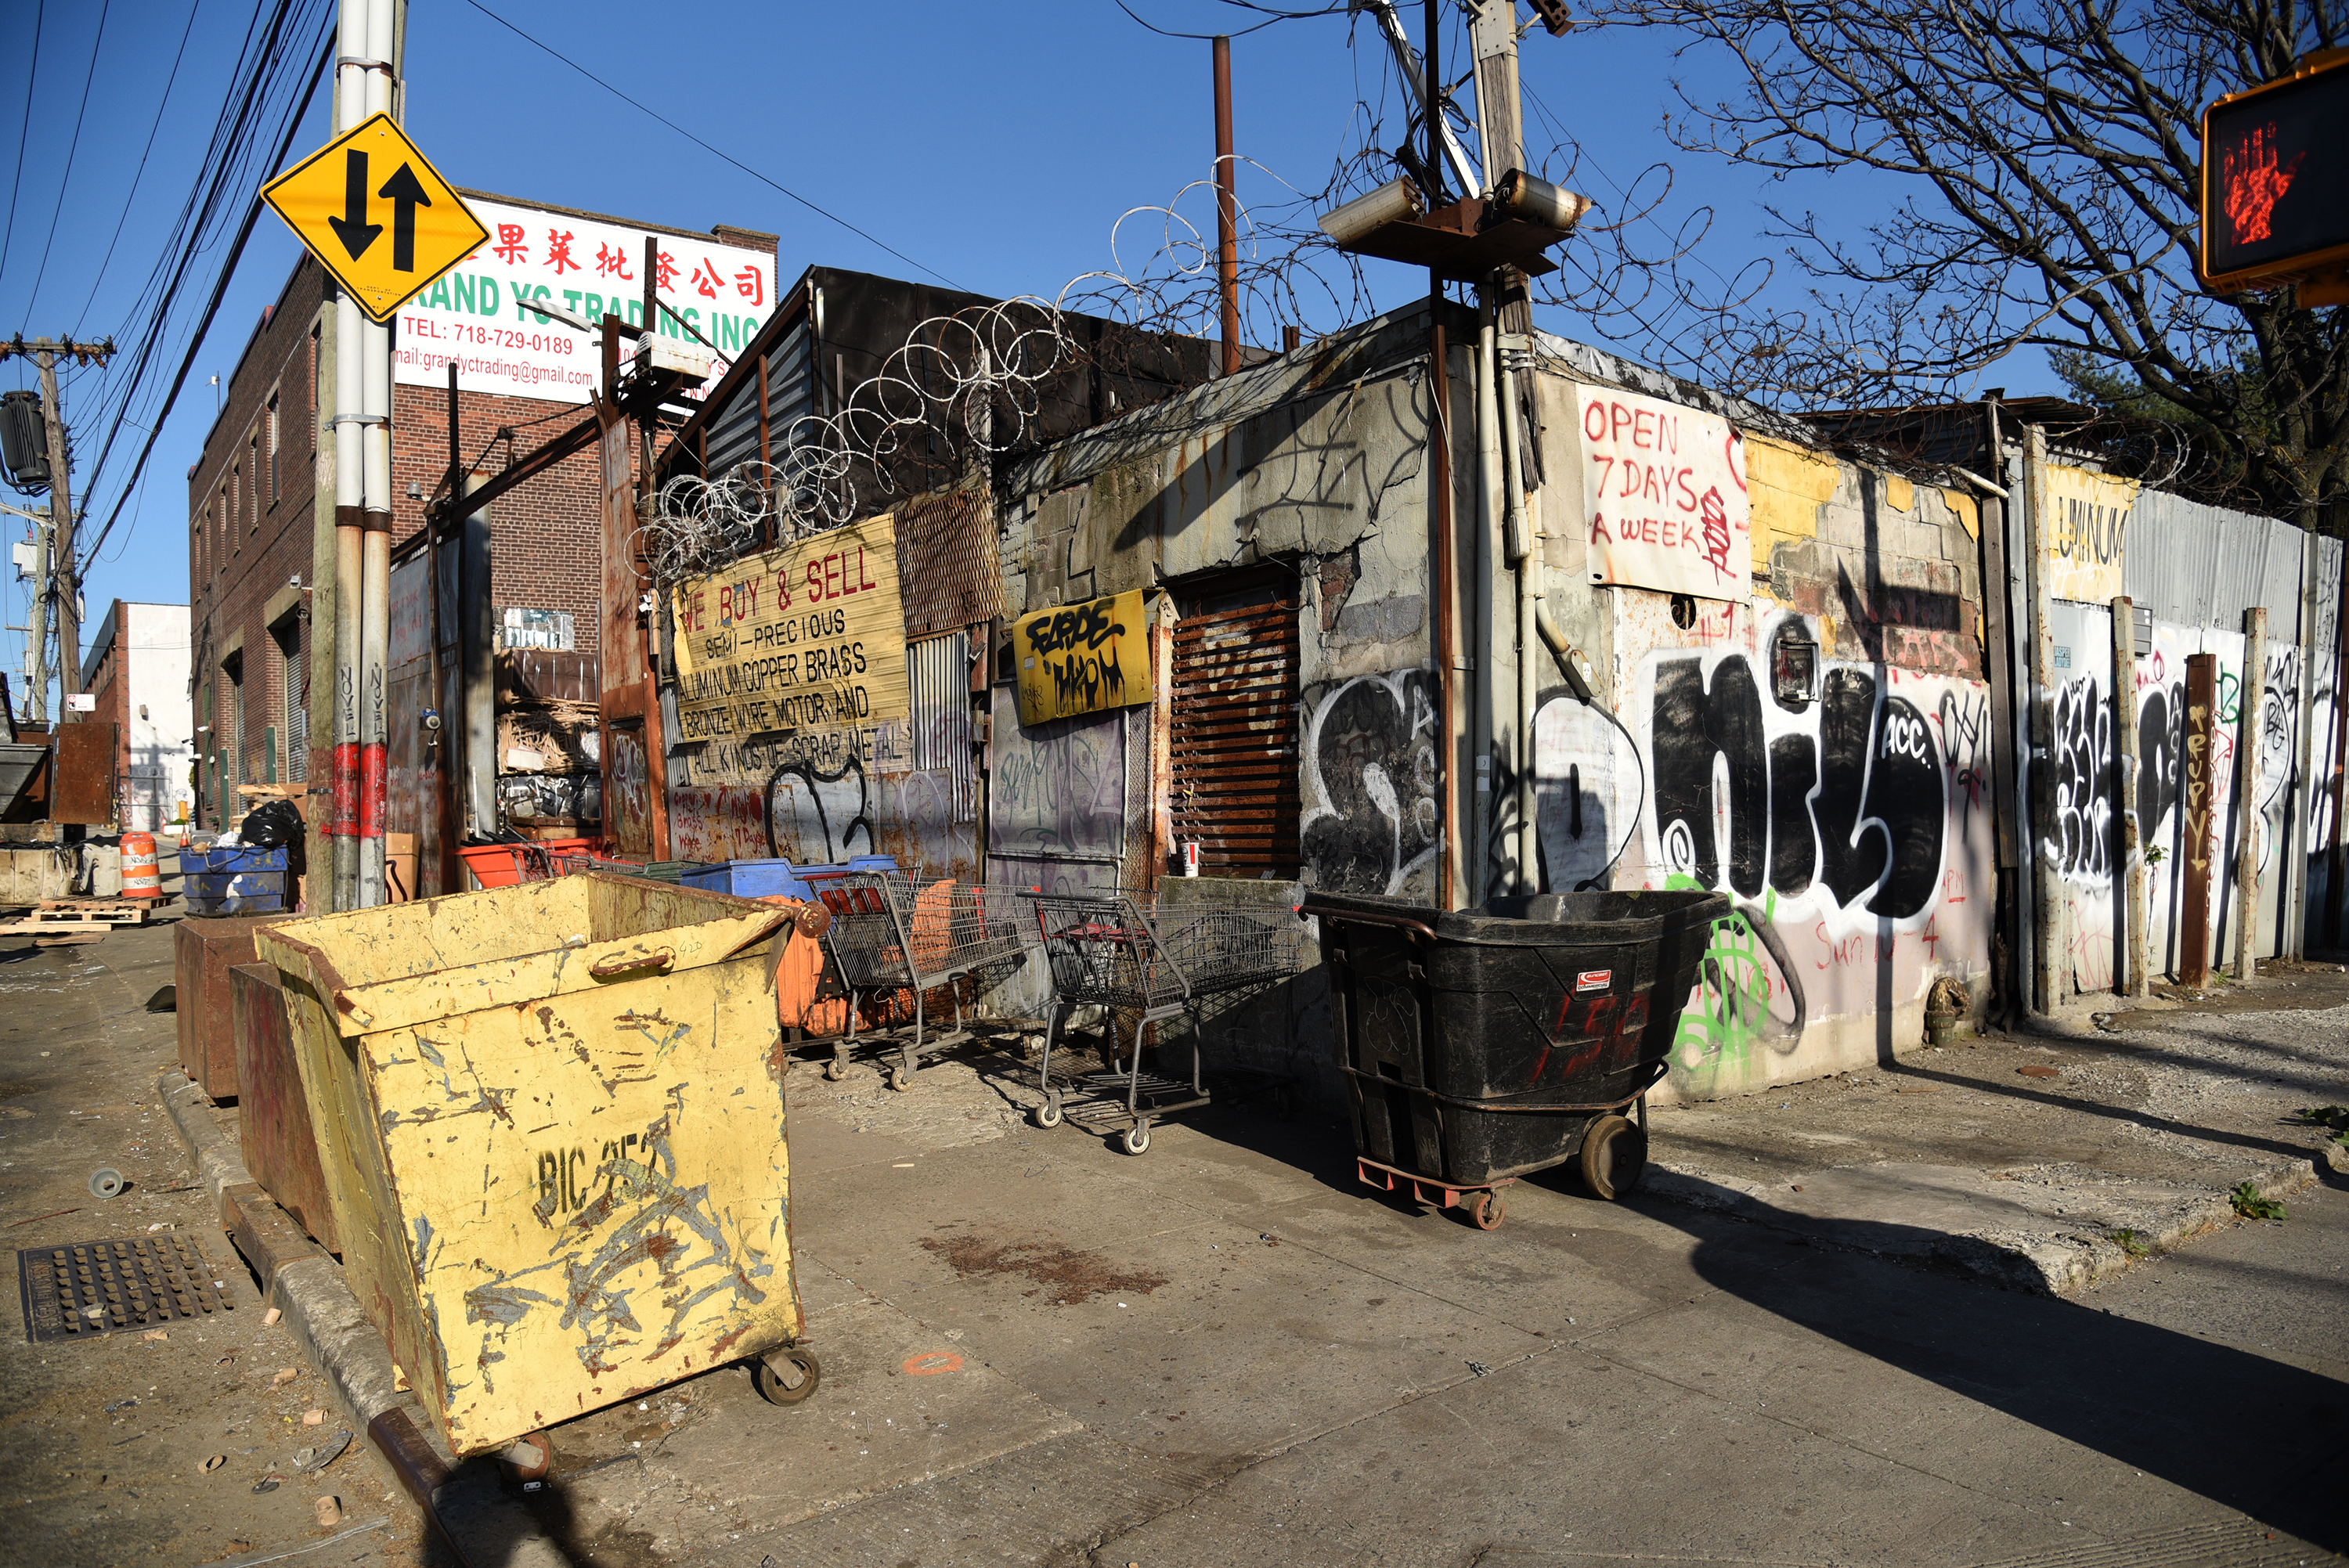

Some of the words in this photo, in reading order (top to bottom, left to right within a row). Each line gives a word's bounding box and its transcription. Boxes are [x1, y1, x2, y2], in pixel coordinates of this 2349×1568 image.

[357, 287, 402, 297] TRANSPORTATION
[404, 316, 447, 339] TEL:
[454, 323, 573, 355] 718-729-0189
[1585, 401, 1677, 455] OPEN
[1593, 453, 1615, 499] 7
[1620, 458, 1698, 513] DAYS
[1591, 511, 1613, 546] A
[1620, 517, 1701, 553] WEEK
[720, 575, 760, 626] BUY
[777, 569, 792, 611] &
[806, 546, 876, 604] SELL
[679, 663, 742, 703] ALUMINUM
[743, 653, 799, 693] COPPER
[805, 641, 867, 683] BRASS
[341, 663, 356, 736] NOVEL
[370, 663, 386, 736] NOVEL
[684, 706, 733, 738] BRONZE
[734, 701, 771, 733] WIRE
[774, 692, 828, 728] MOTOR
[835, 685, 869, 722] AND
[694, 744, 716, 774] ALL
[765, 737, 784, 770] OF
[792, 732, 840, 766] SCRAP
[848, 726, 903, 762] METAL
[677, 813, 703, 831] Brass
